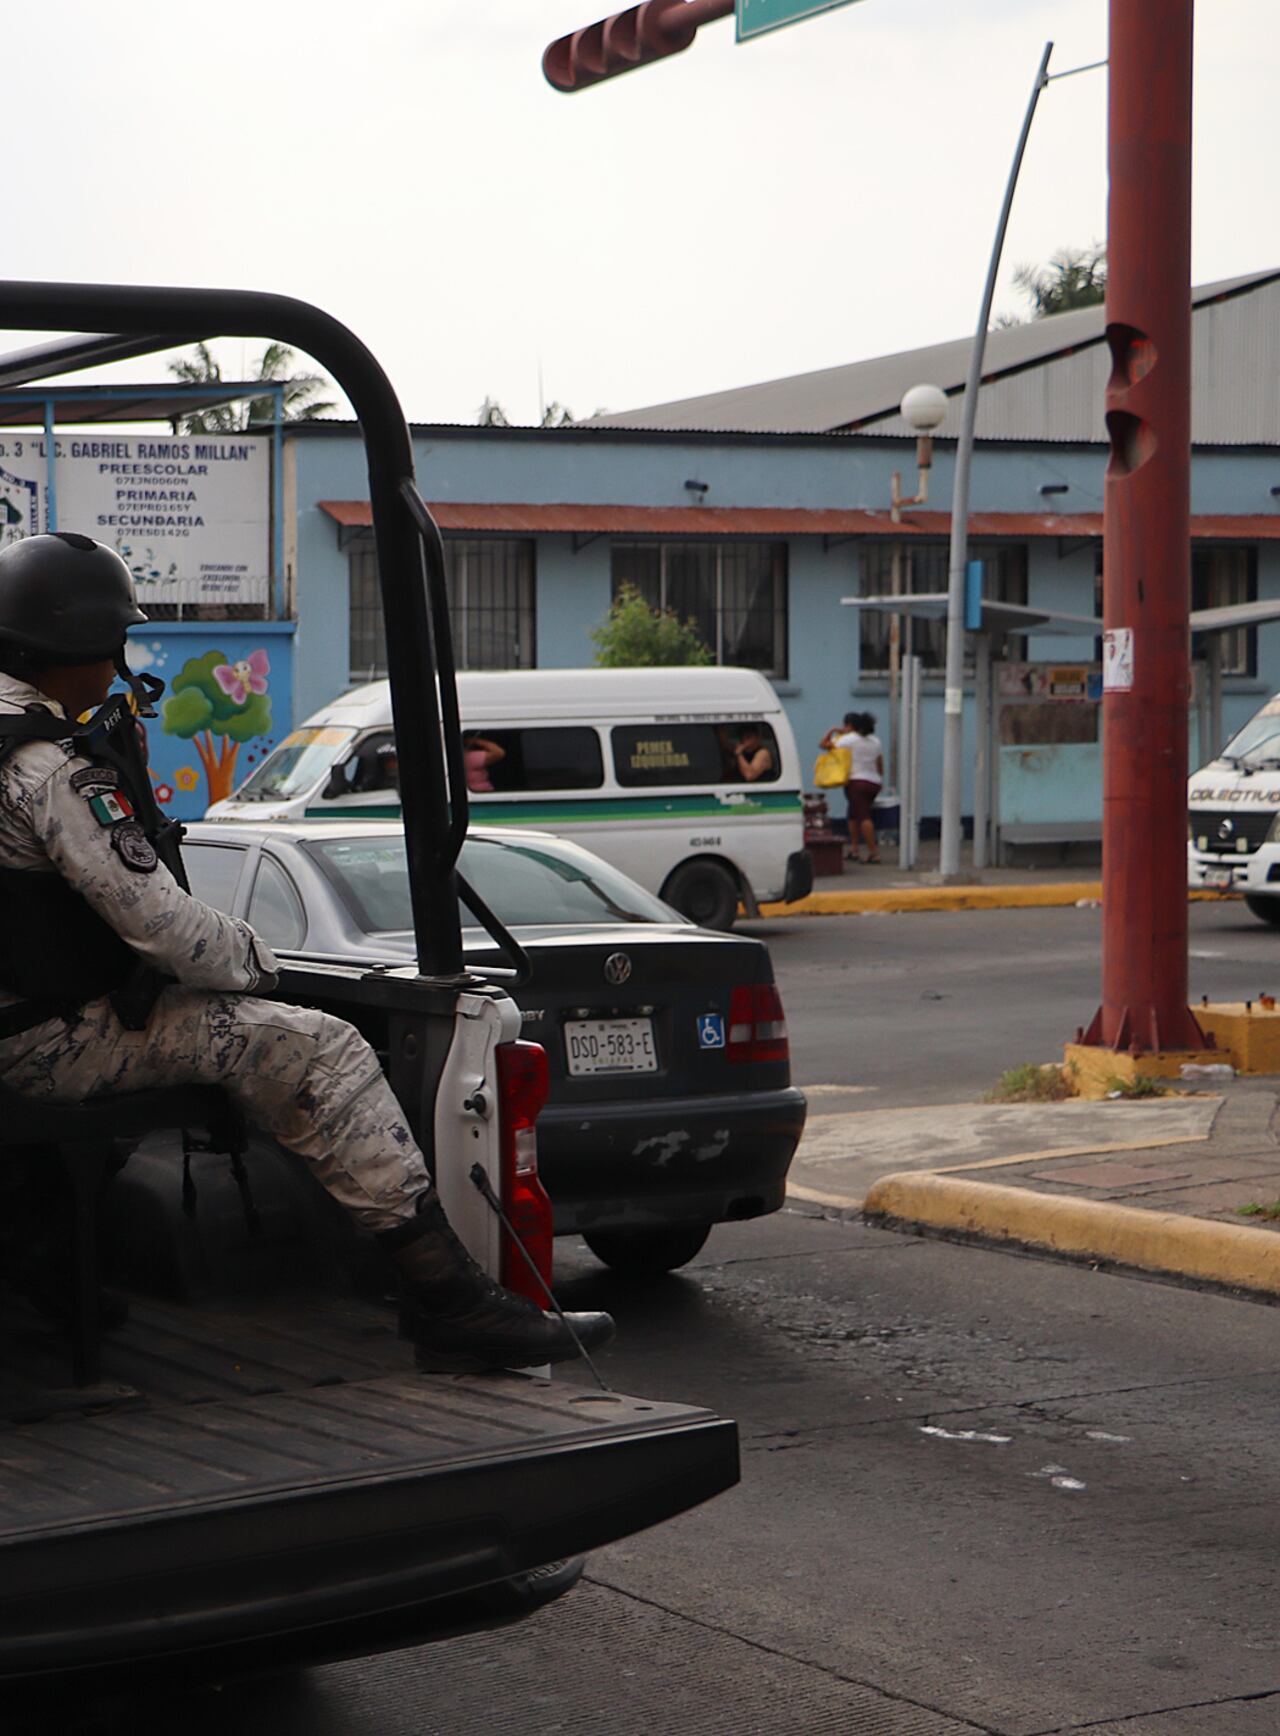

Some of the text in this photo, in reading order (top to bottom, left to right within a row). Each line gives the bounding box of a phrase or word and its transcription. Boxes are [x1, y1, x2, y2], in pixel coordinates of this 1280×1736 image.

[15, 442, 23, 458] 3
[71, 442, 131, 460] GABRIEL
[137, 443, 190, 460] RAMOS
[98, 463, 209, 476] PREESCOLAR
[115, 490, 197, 501] PRIMARIA
[97, 514, 205, 527] SECUNDARIA
[570, 1032, 652, 1059] DSD-583-E
